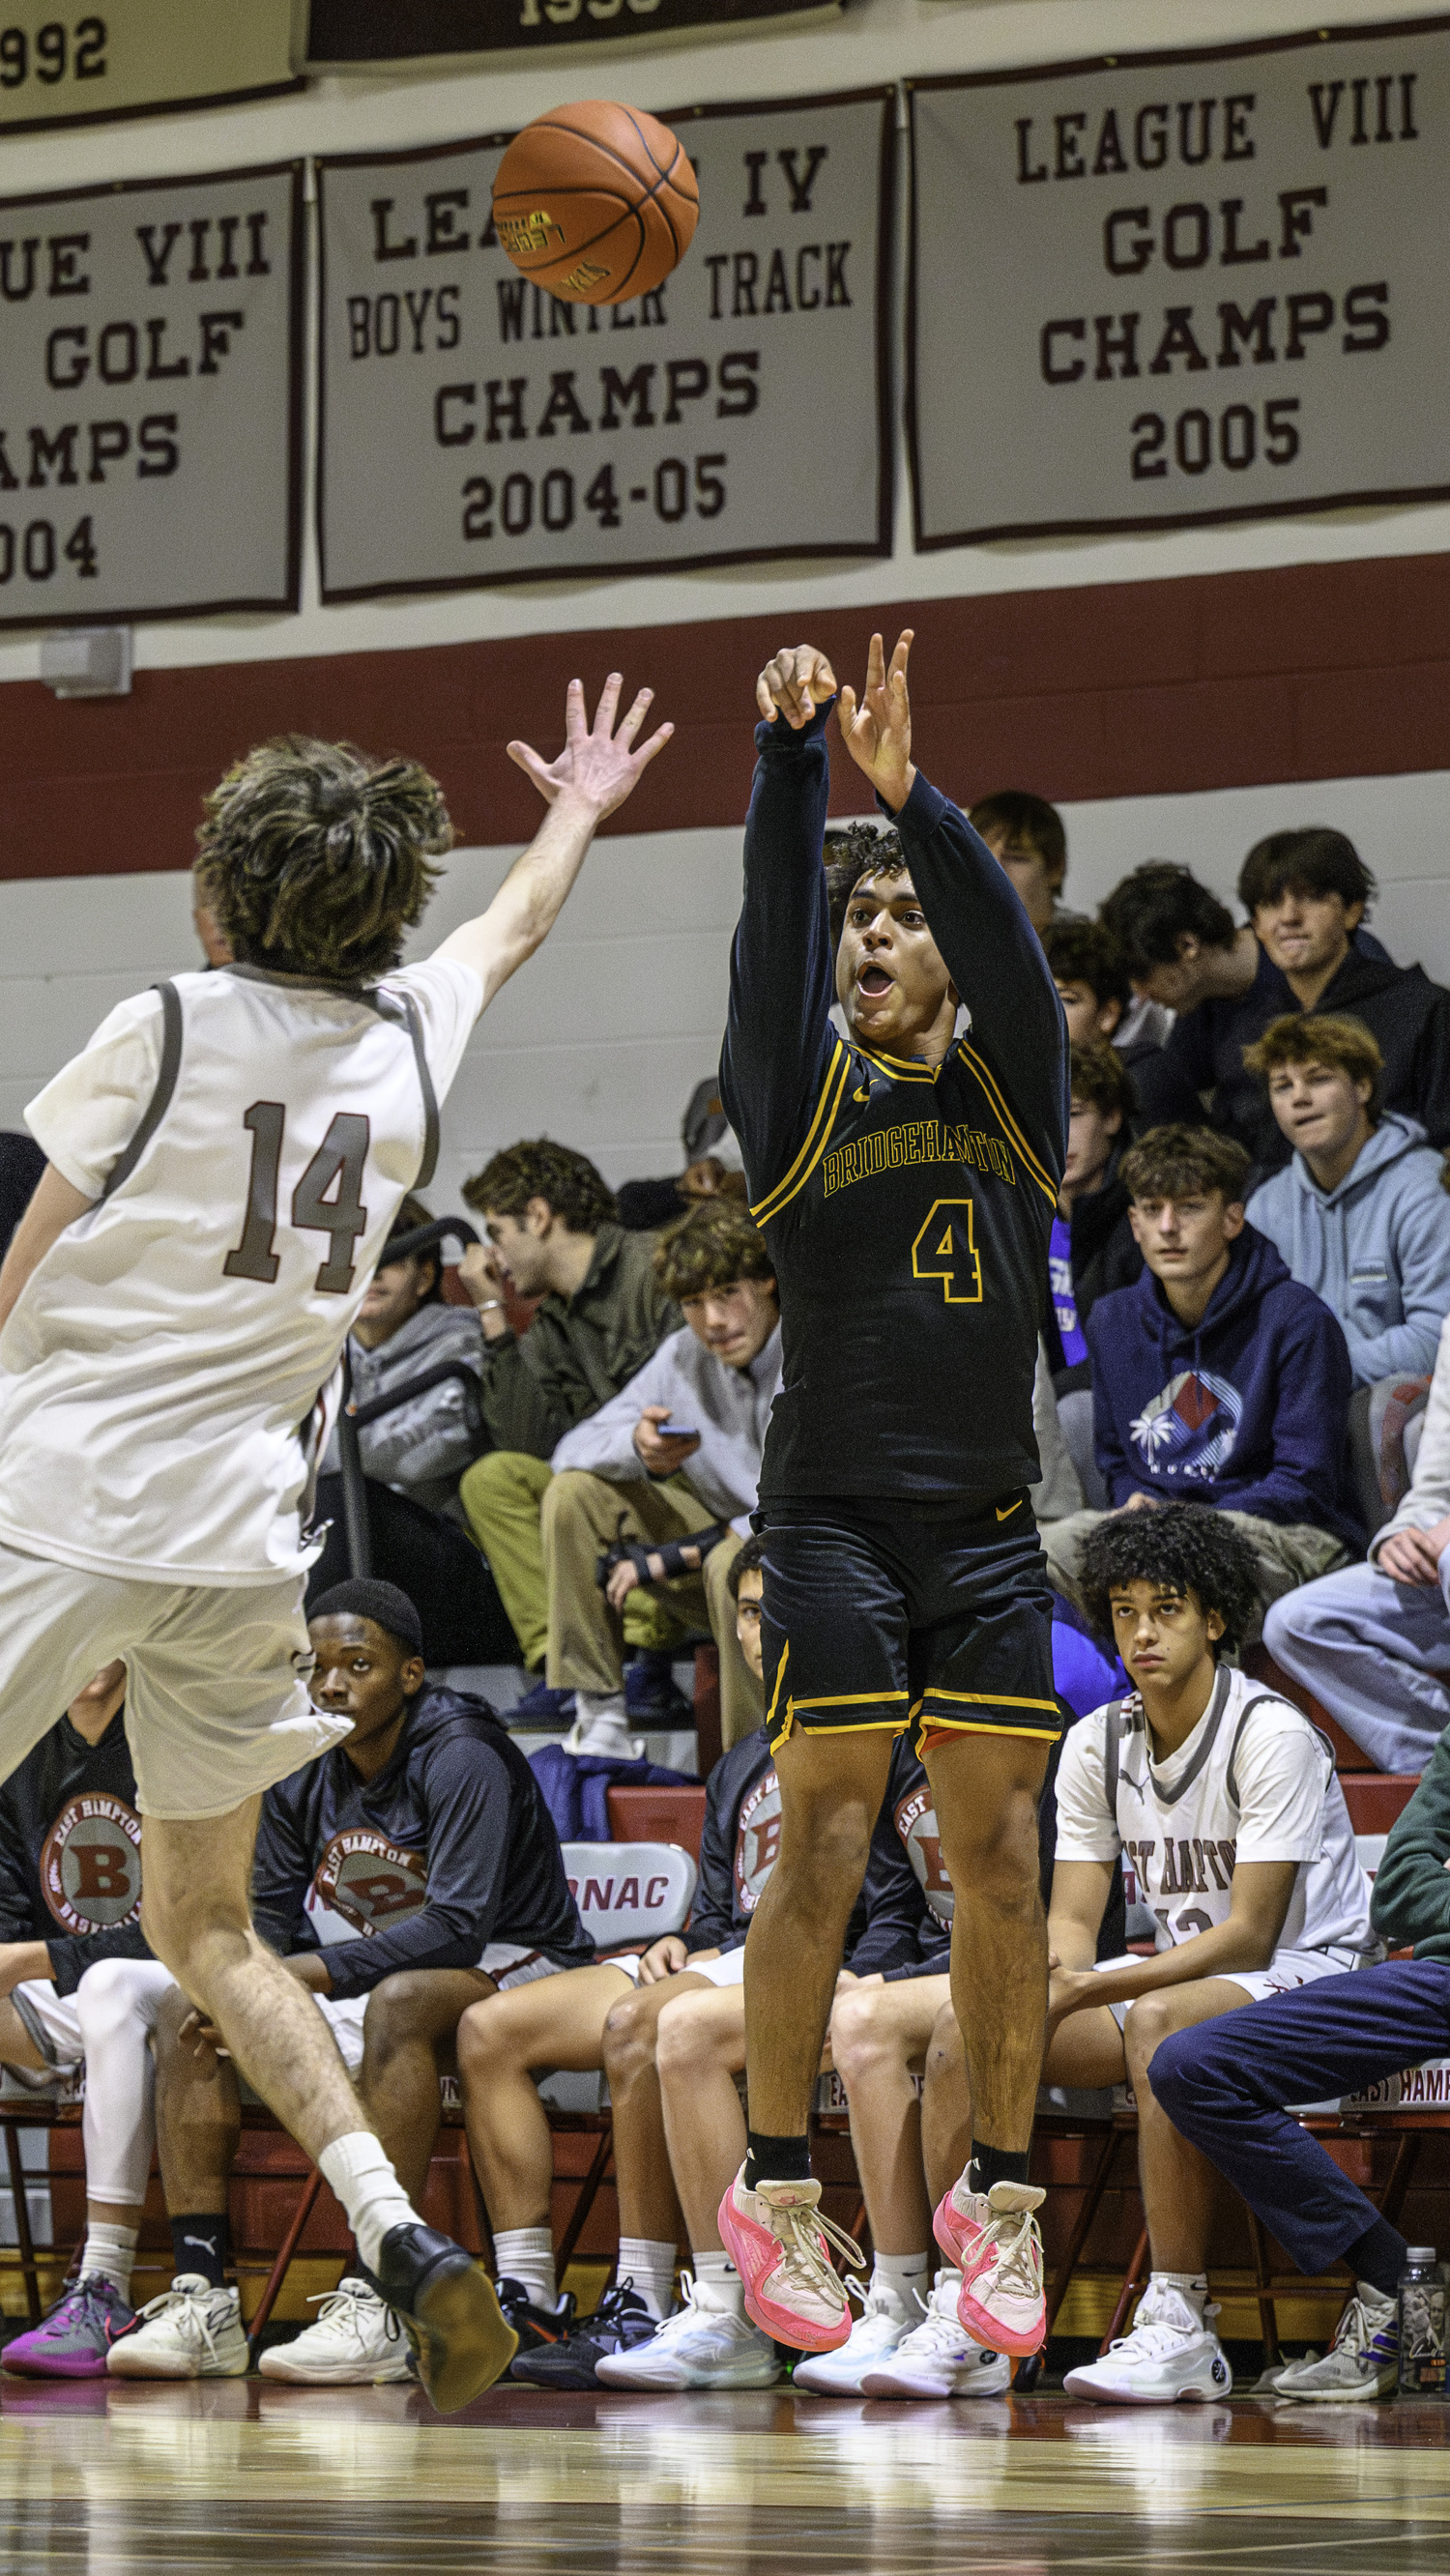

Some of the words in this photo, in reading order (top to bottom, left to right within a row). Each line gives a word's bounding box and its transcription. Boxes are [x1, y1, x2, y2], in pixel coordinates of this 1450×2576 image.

[1014, 94, 1257, 185] LEAGUE
[1307, 73, 1419, 149] VIII
[742, 145, 828, 217] IV
[136, 212, 271, 286] VIII
[1103, 187, 1329, 276] GOLF
[347, 285, 461, 360] BOYS
[705, 242, 853, 320] TRACK
[1039, 281, 1391, 385] CHAMPS
[45, 310, 245, 390] GOLF
[432, 350, 761, 448] CHAMPS
[1129, 398, 1301, 480] 2005
[461, 454, 729, 541] 2004-05
[222, 1100, 370, 1294] 14
[912, 1199, 983, 1303] 4
[898, 1795, 925, 1838] EAST
[69, 1844, 130, 1899] B
